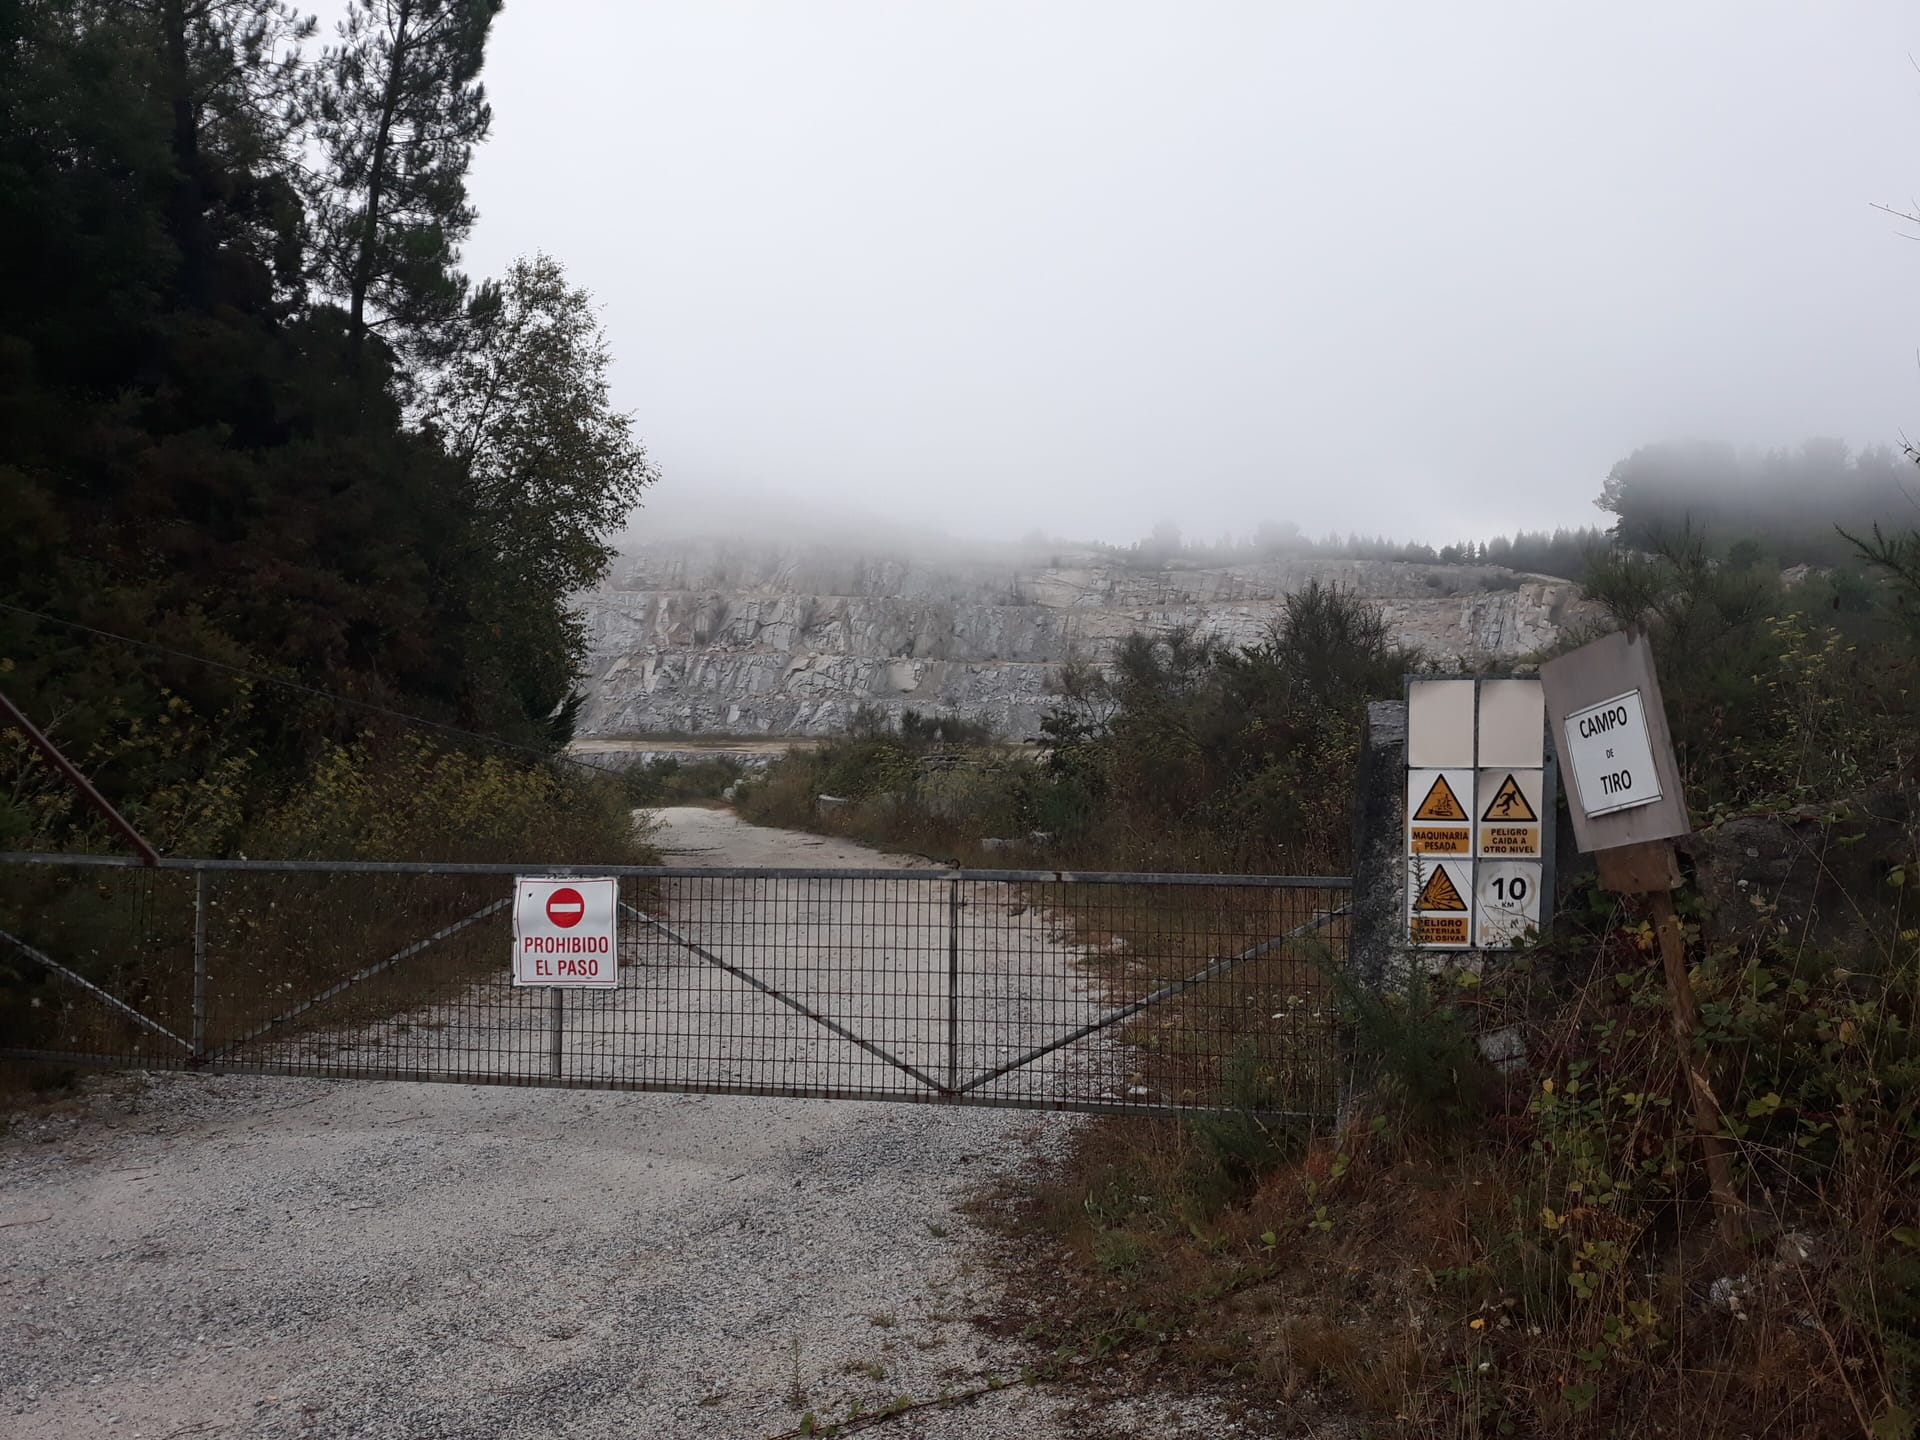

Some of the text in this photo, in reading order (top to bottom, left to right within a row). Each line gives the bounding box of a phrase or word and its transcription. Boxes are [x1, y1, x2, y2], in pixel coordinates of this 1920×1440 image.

[1579, 706, 1627, 738] CAMPO
[1606, 748, 1614, 759] DE
[1600, 769, 1632, 795] TIRO
[1412, 831, 1469, 840] MAQUINARIA
[1491, 828, 1528, 836] PELIGRO
[1424, 842, 1457, 850] PESADA
[1492, 837, 1527, 845] CAIDA A
[1483, 846, 1535, 854] OTRO NIVEL
[1491, 877, 1527, 901] 10
[524, 936, 609, 954] PROHIBIDO
[535, 959, 598, 976] EL PASO
